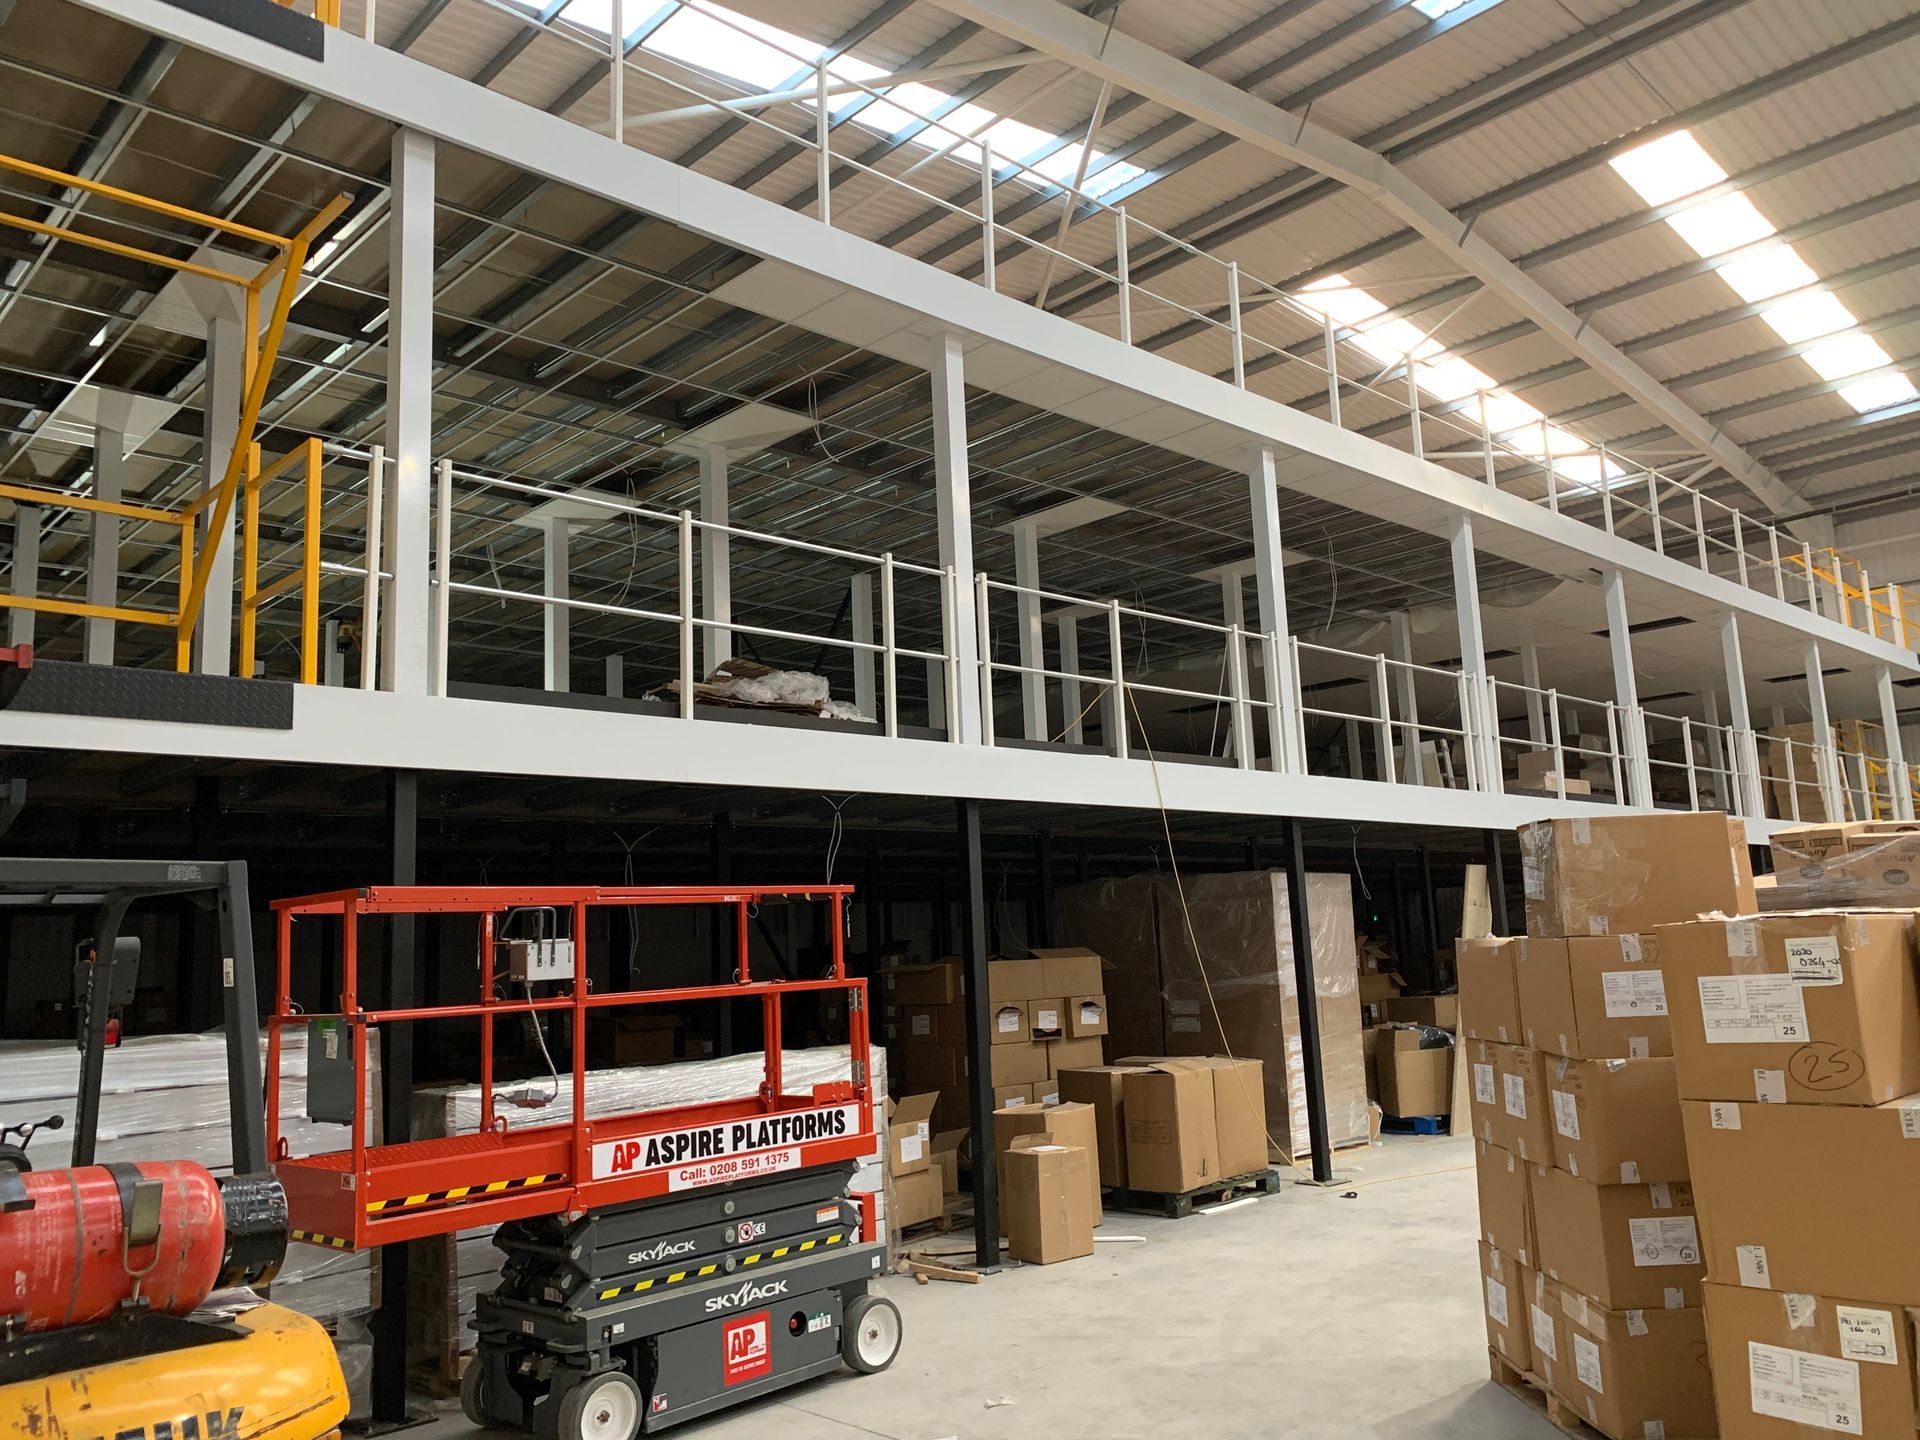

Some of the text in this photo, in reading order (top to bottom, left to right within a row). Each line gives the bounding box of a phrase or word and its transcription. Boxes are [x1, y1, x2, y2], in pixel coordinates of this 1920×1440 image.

[1782, 1026, 1797, 1036] 25
[1804, 1048, 1850, 1084] 25
[611, 1109, 846, 1173] AP ASPIRE PLATFORMS
[679, 1152, 790, 1181] Call: 0208 591 1375
[692, 1165, 777, 1187] WWW.ASPIREPLATFORMS.CO.UK
[627, 1240, 696, 1264] SKYJACK
[1684, 1251, 1693, 1260] 20
[705, 1279, 789, 1313] SKYJACK
[730, 1328, 756, 1361] AP
[1835, 1414, 1850, 1425] 25
